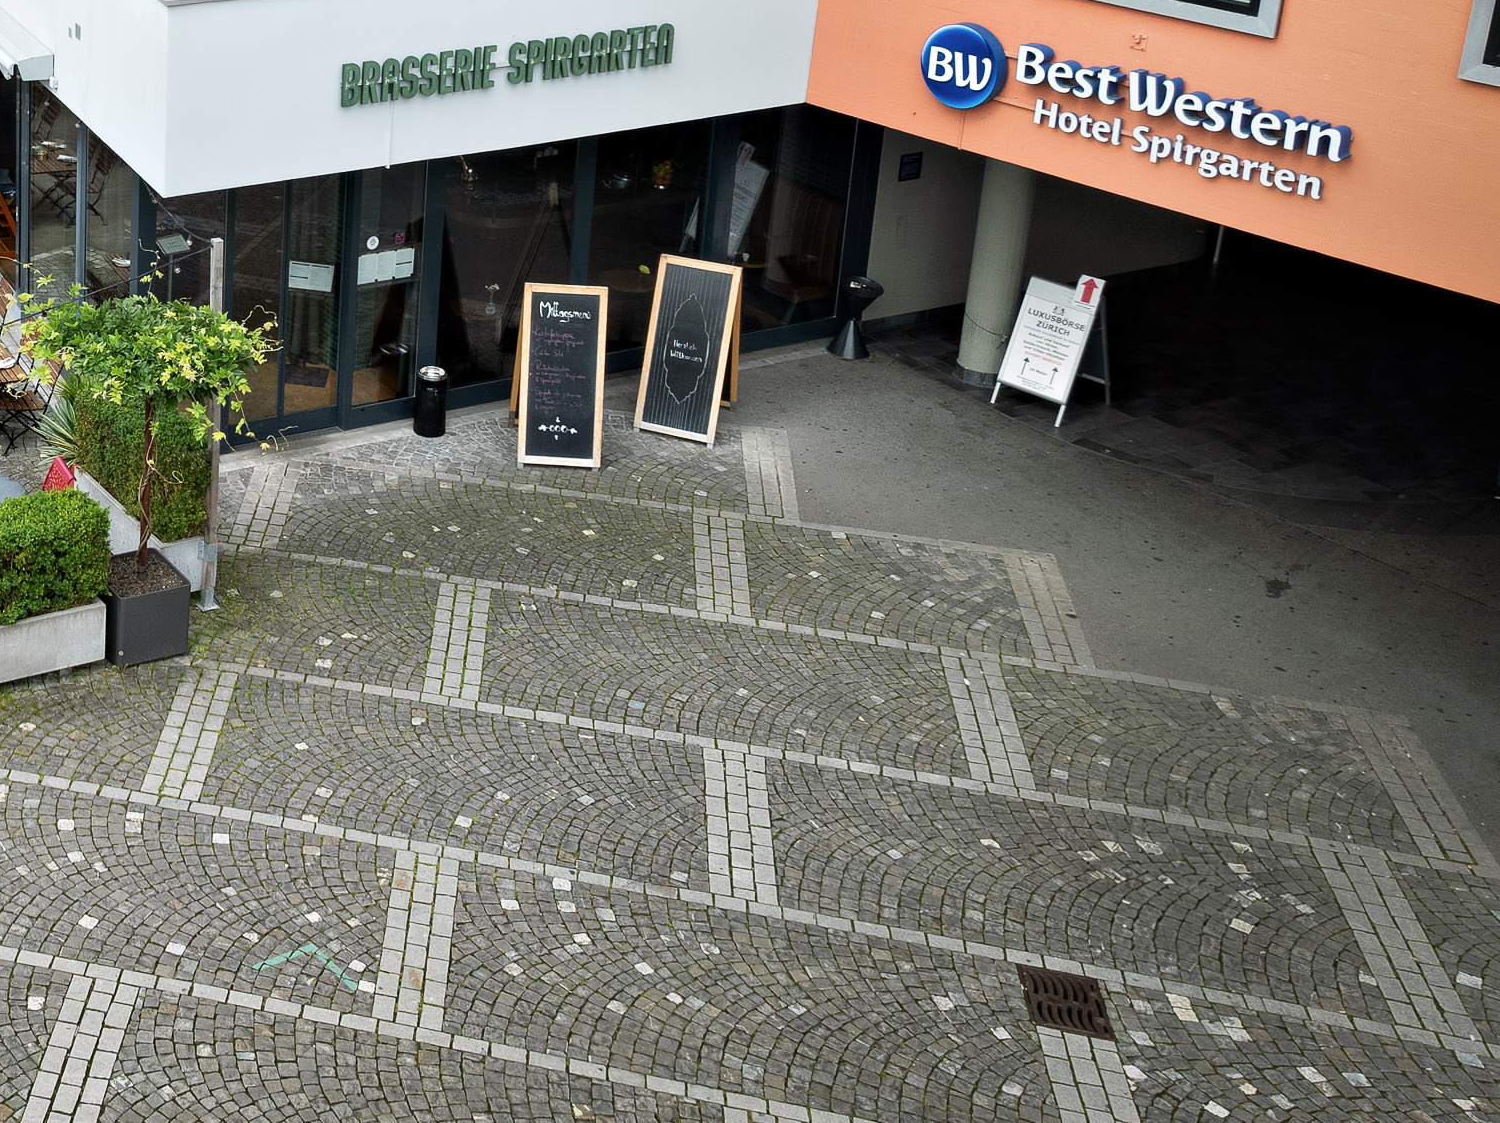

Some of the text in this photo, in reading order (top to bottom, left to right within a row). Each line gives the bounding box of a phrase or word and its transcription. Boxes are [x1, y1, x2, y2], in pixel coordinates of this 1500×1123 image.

[341, 23, 675, 108] BRASSERIE SPIRGARTEN
[927, 45, 992, 91] BW
[1015, 43, 1352, 162] Best Western
[1033, 99, 1323, 199] Hotel Spirgarten
[1028, 307, 1086, 331] LUXUSBÖRSE
[1036, 319, 1071, 336] ZÜRICH
